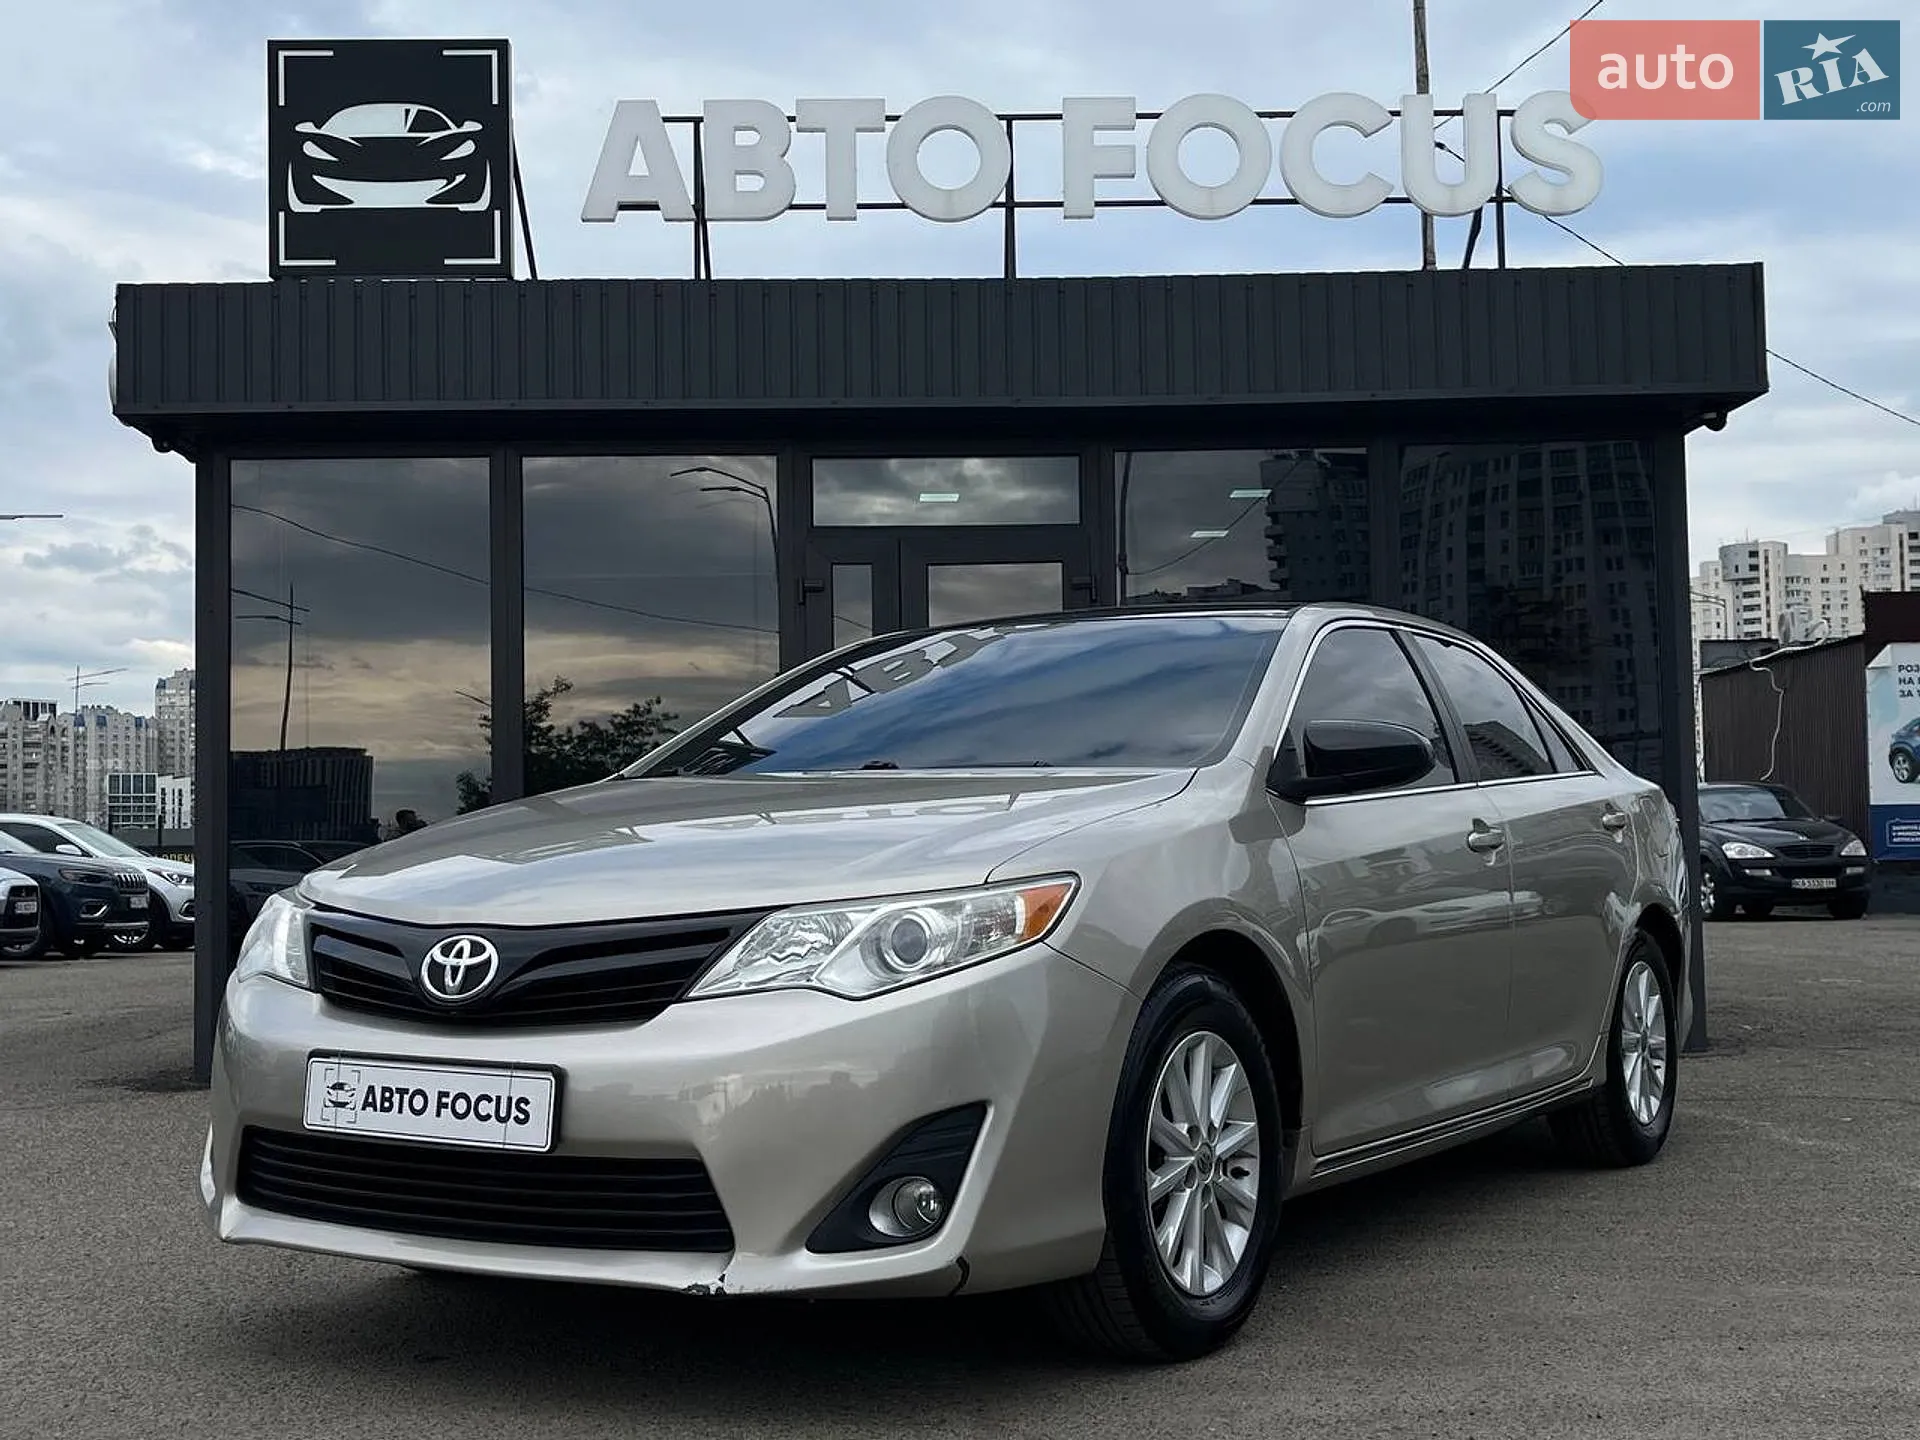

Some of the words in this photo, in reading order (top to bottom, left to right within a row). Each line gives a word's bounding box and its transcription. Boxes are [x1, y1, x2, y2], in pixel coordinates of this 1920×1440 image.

[581, 95, 1013, 222] АВТО
[1062, 90, 1605, 221] FOCUS
[361, 1085, 429, 1117] АВТО
[435, 1090, 531, 1125] FOCUS
